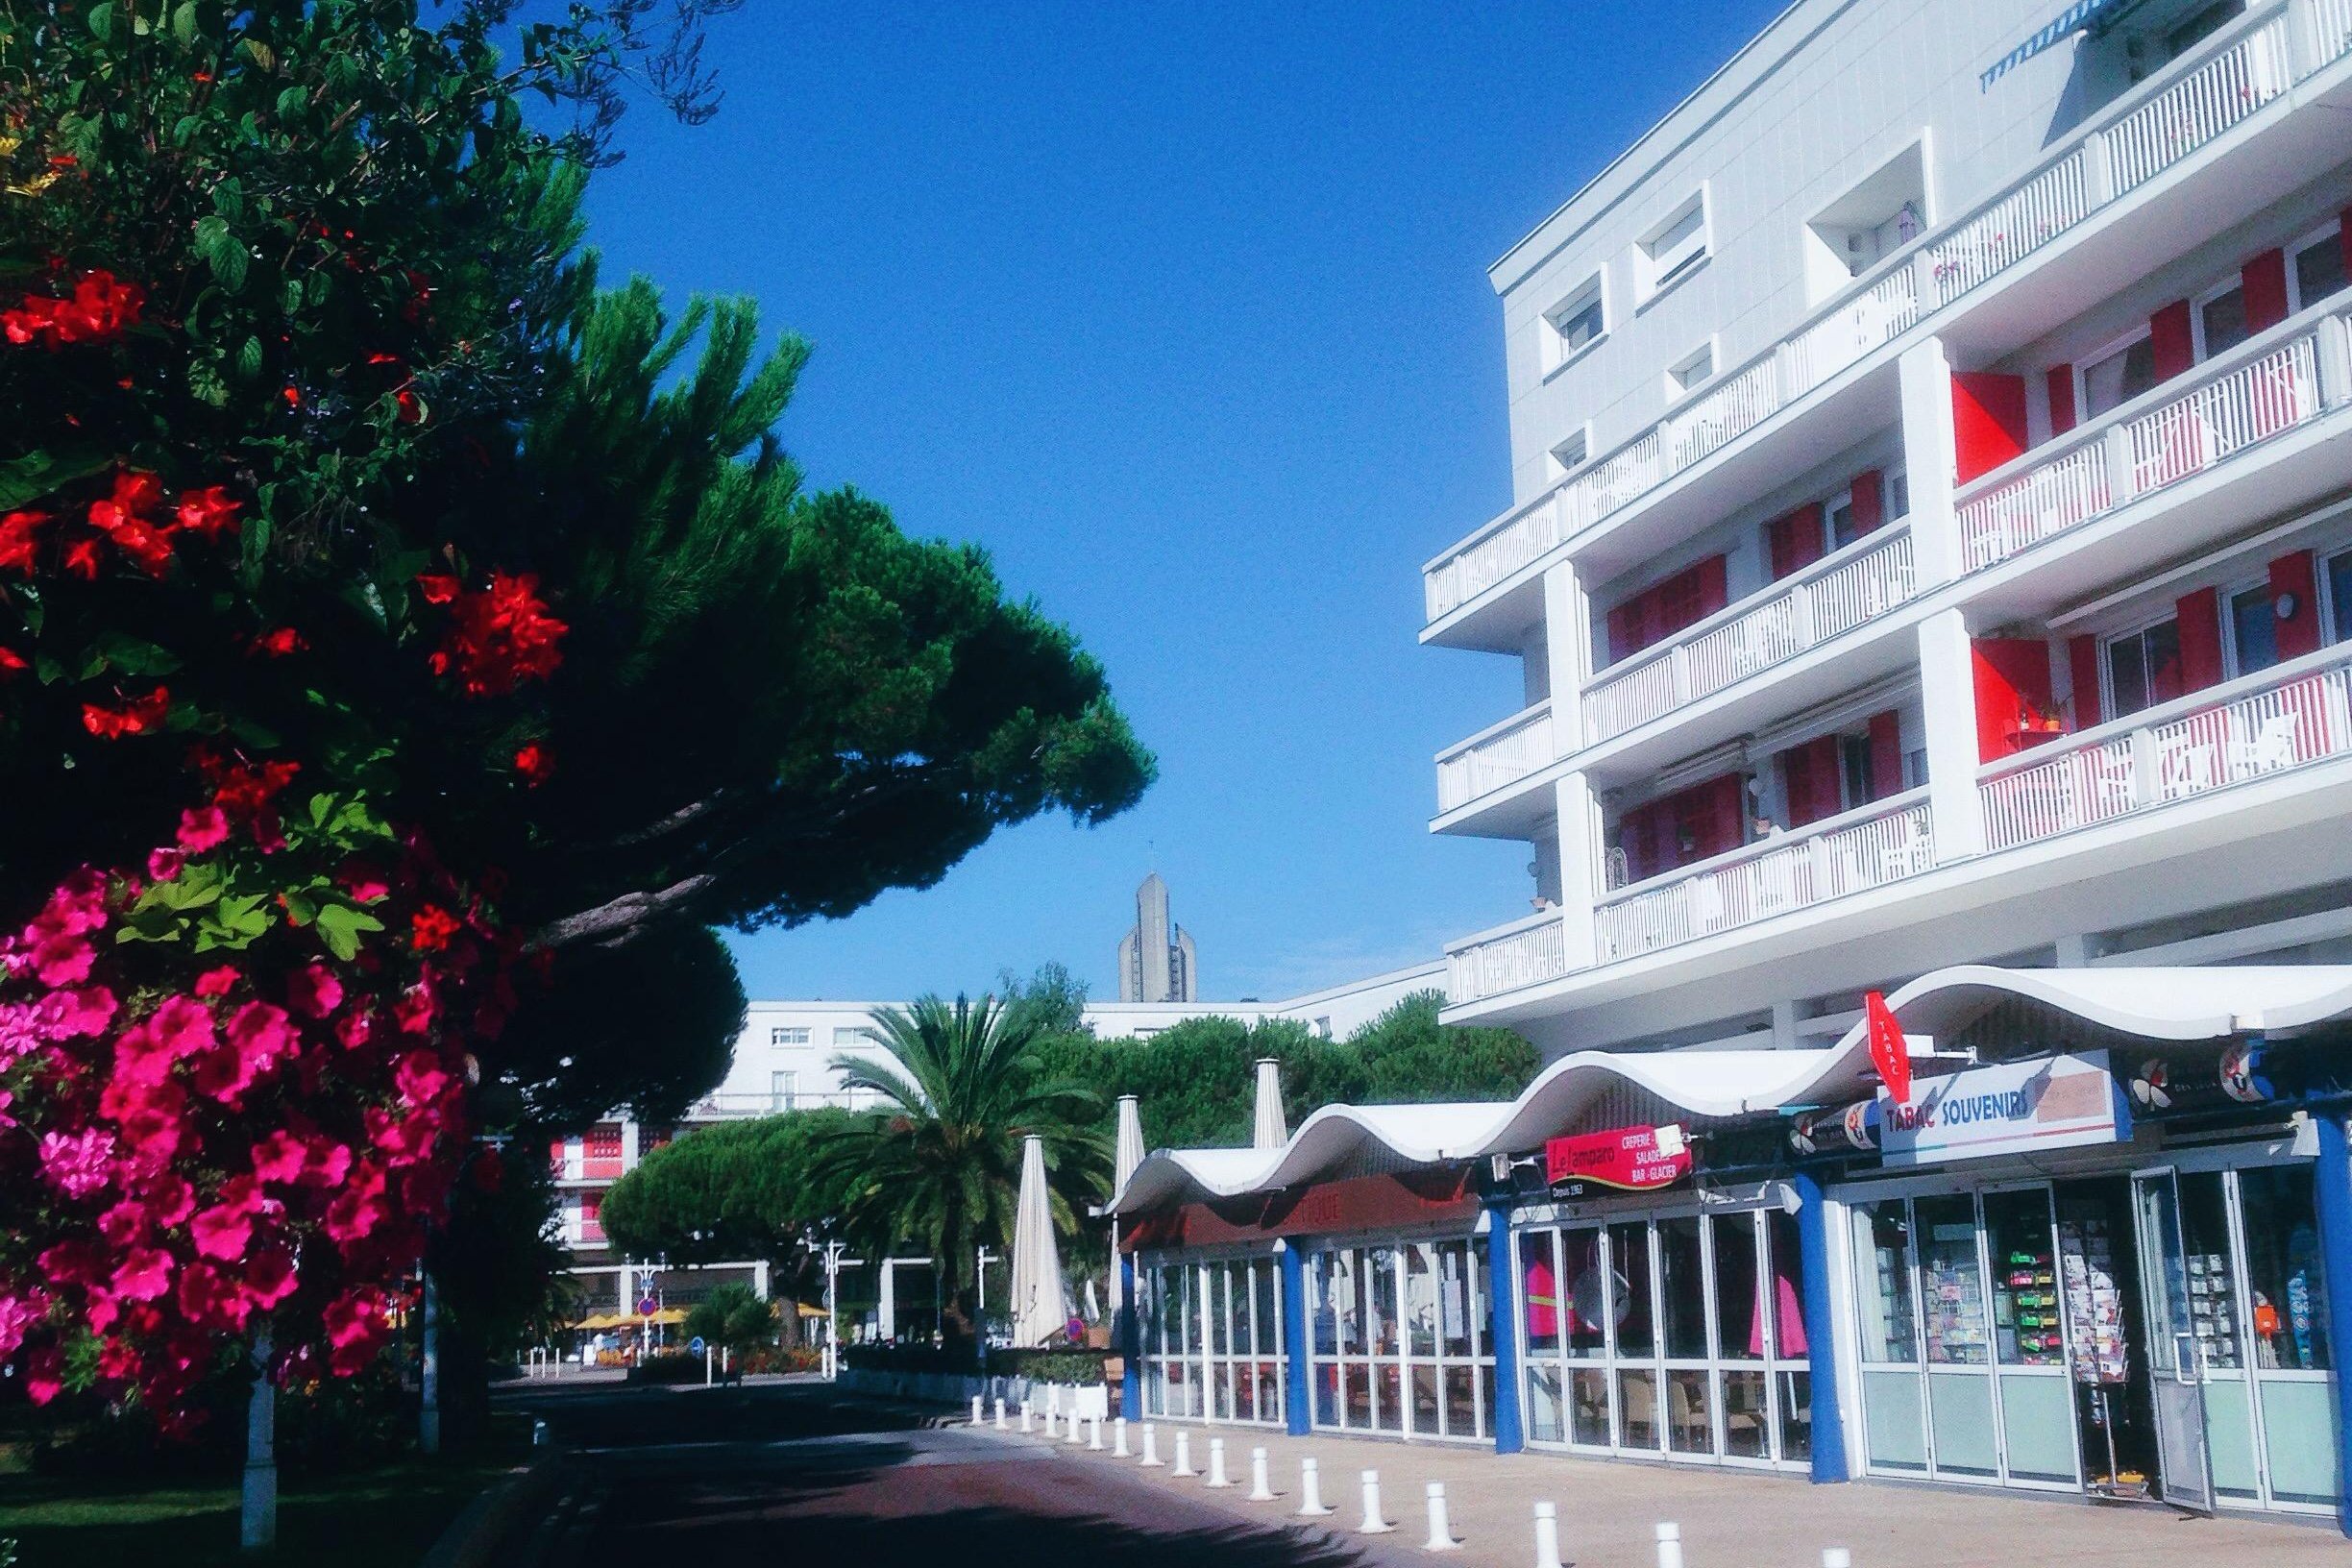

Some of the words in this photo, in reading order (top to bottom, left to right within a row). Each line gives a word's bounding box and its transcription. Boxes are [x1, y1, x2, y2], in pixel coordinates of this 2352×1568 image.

[1877, 1021, 1899, 1075] TABAC
[1886, 1103, 1936, 1133] TABAC
[1942, 1090, 2029, 1126] SOUVENIRS
[1631, 1167, 1646, 1182] BAR
[1650, 1164, 1678, 1180] GLACIER
